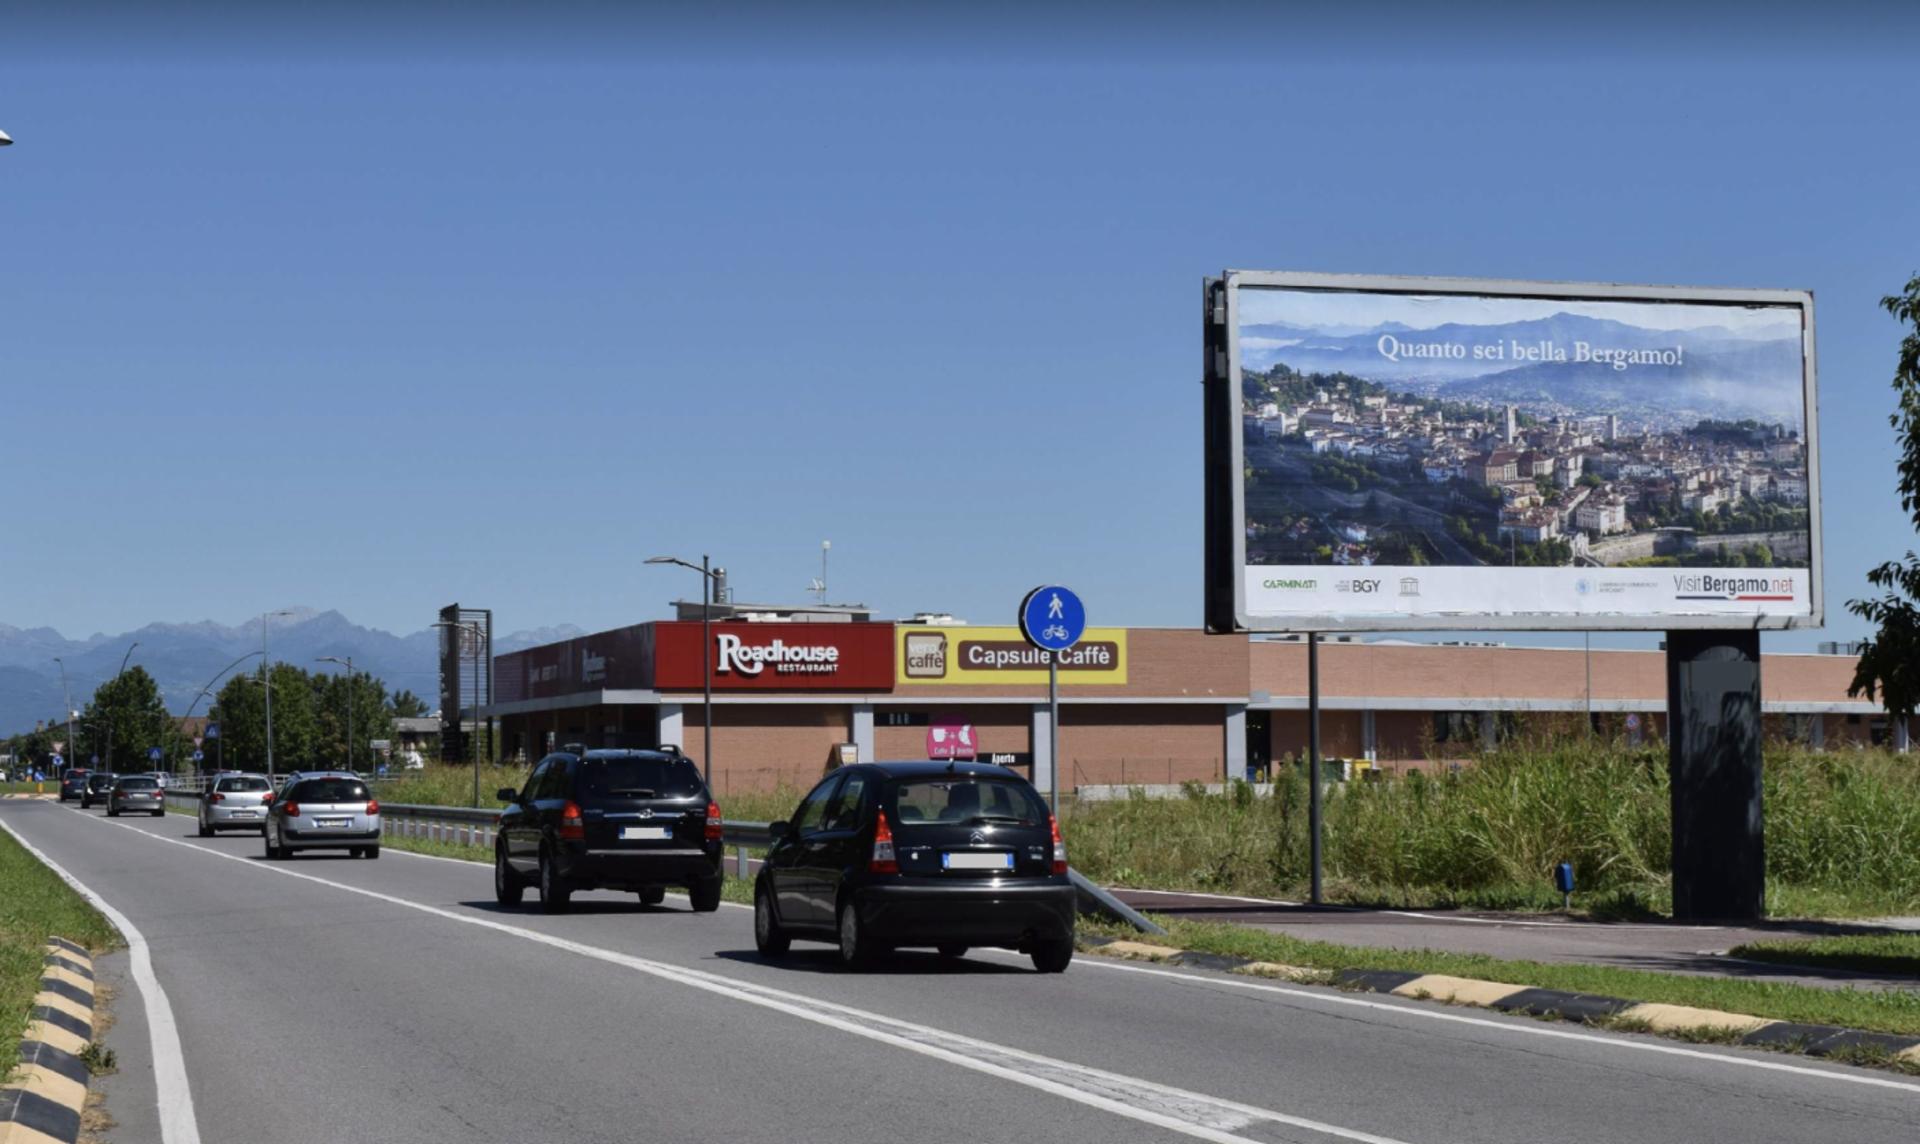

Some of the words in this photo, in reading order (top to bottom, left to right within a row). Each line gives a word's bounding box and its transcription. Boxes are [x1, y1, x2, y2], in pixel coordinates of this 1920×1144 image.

[1377, 334, 1465, 361] Quanto
[1473, 339, 1504, 360] sei
[1512, 340, 1567, 362] bella
[1573, 341, 1684, 371] Bergamo!
[1263, 579, 1317, 589] CARMINATI
[1352, 579, 1381, 593] BGY
[1673, 574, 1794, 595] VisitBergamo.net
[717, 634, 839, 674] Roadhouse
[908, 653, 943, 668] caffè
[968, 645, 1050, 668] Capsule
[1058, 646, 1110, 664] Caffè
[777, 664, 839, 672] RESTAURANT
